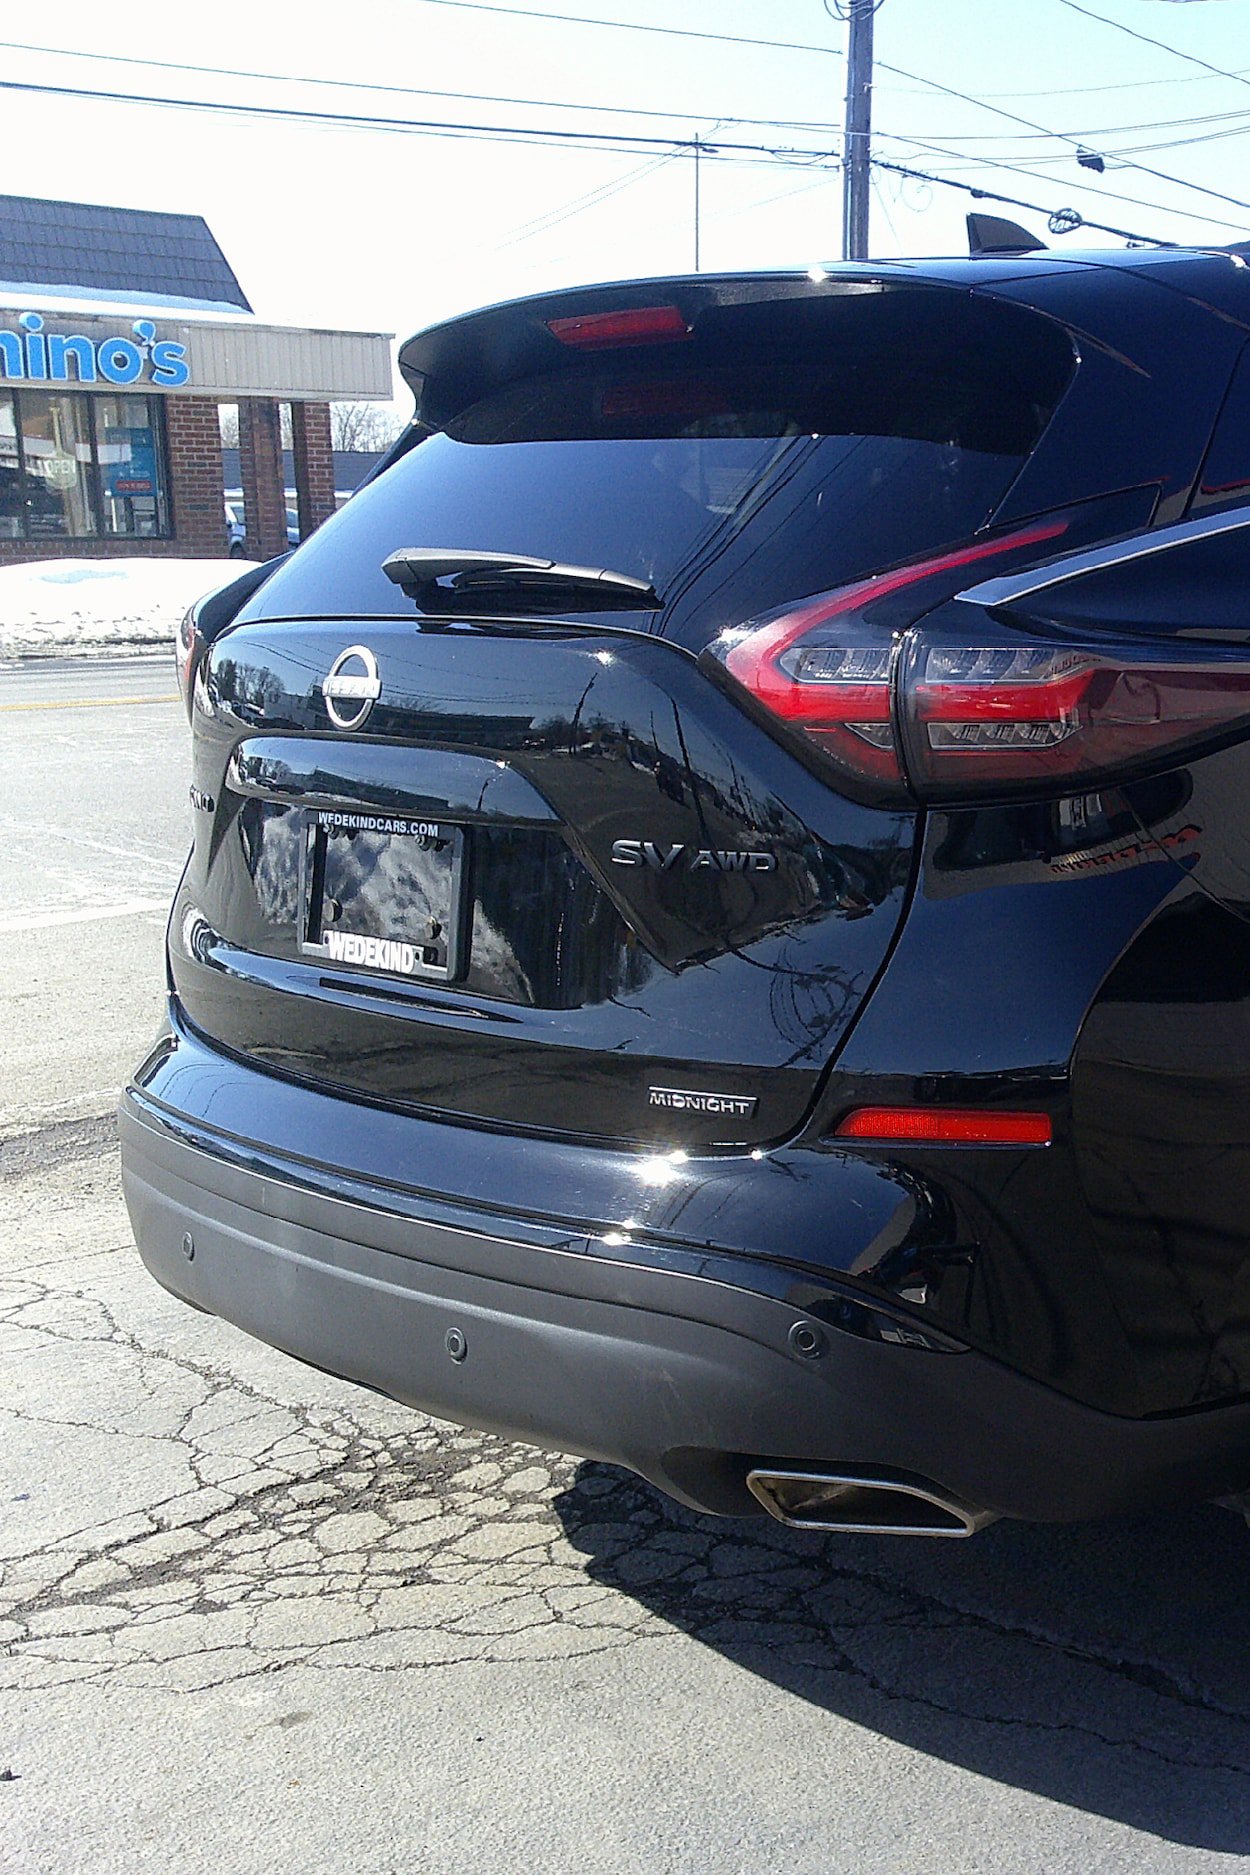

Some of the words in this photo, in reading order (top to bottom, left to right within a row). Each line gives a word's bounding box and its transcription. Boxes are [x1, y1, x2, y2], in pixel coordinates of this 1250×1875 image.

[318, 811, 439, 837] WEDEKINDCARS.COM
[611, 839, 685, 871] SV
[690, 850, 778, 873] AWD
[328, 929, 415, 974] WEDEKIND
[649, 1091, 750, 1114] MIDNIGHT
